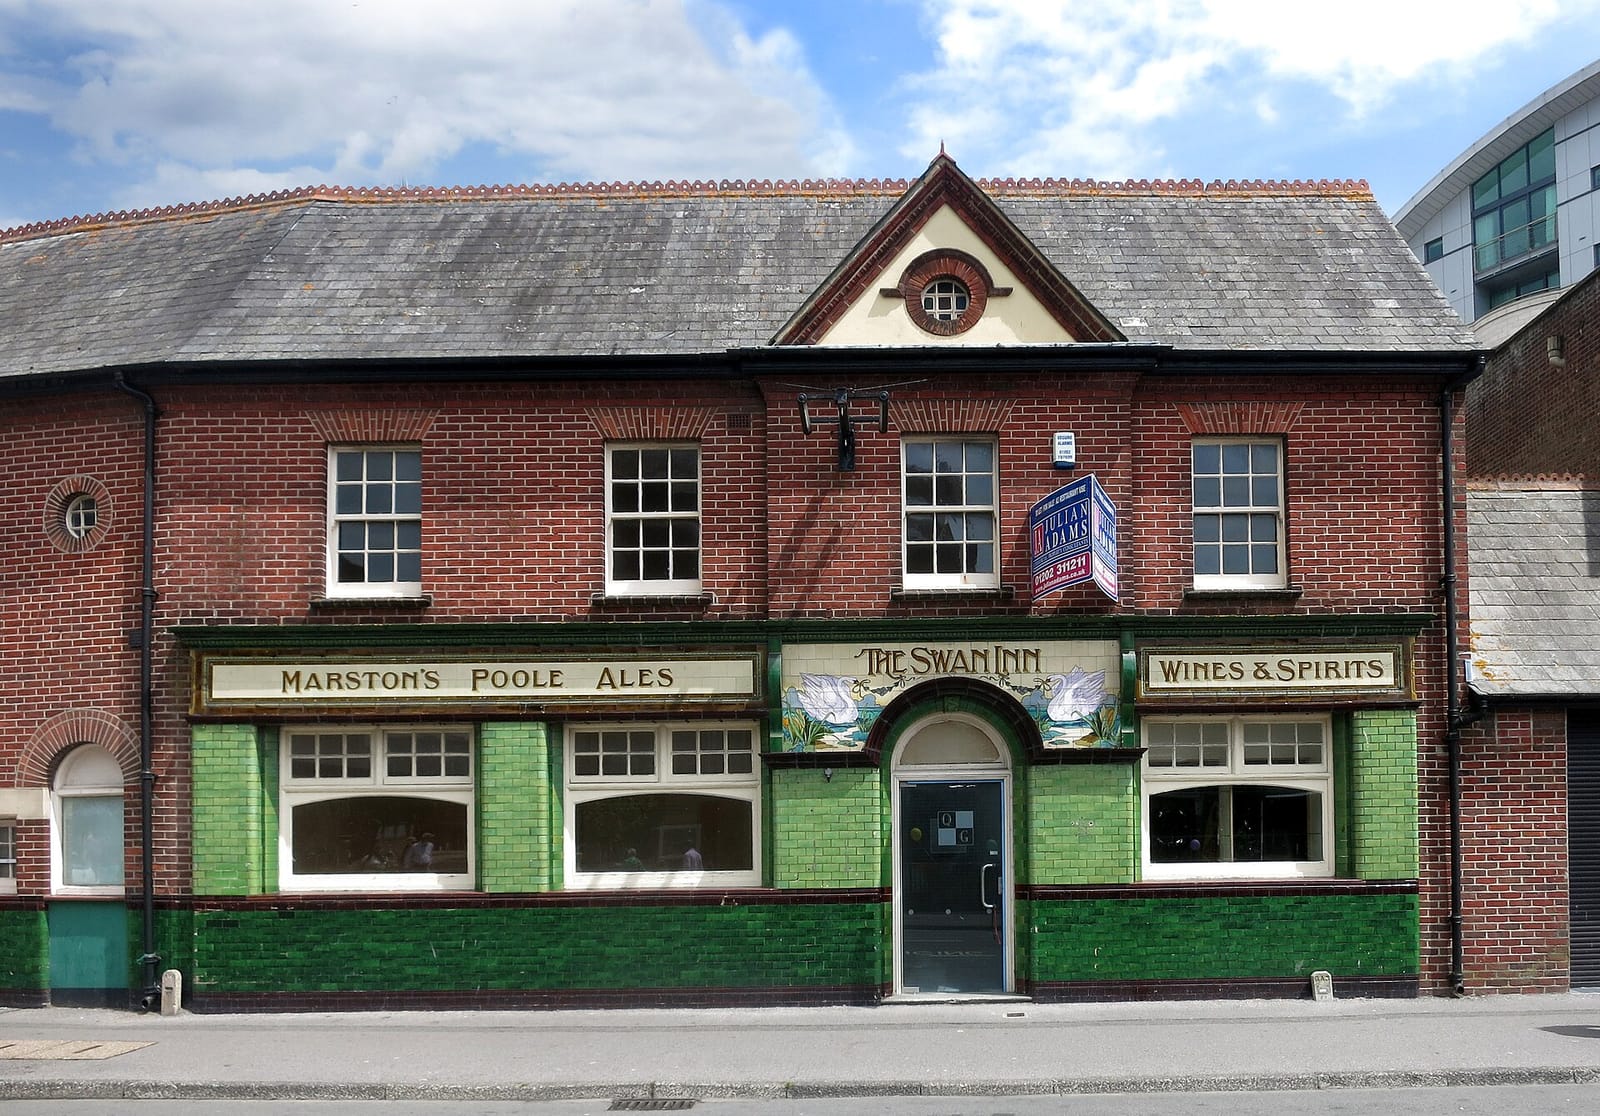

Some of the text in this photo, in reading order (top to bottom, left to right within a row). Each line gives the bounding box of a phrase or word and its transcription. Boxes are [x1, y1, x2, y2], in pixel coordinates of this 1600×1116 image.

[1045, 501, 1088, 535] JULIAN
[1045, 519, 1088, 553] ADAMS
[1034, 567, 1054, 586] 01202
[1056, 555, 1086, 575] 311211
[854, 645, 1041, 678] THE SWAN INN
[1159, 659, 1384, 683] WINES & SPIRITS
[281, 667, 674, 693] MARSTON'S POOLE ALES
[942, 812, 952, 827] Q
[960, 829, 969, 843] G
